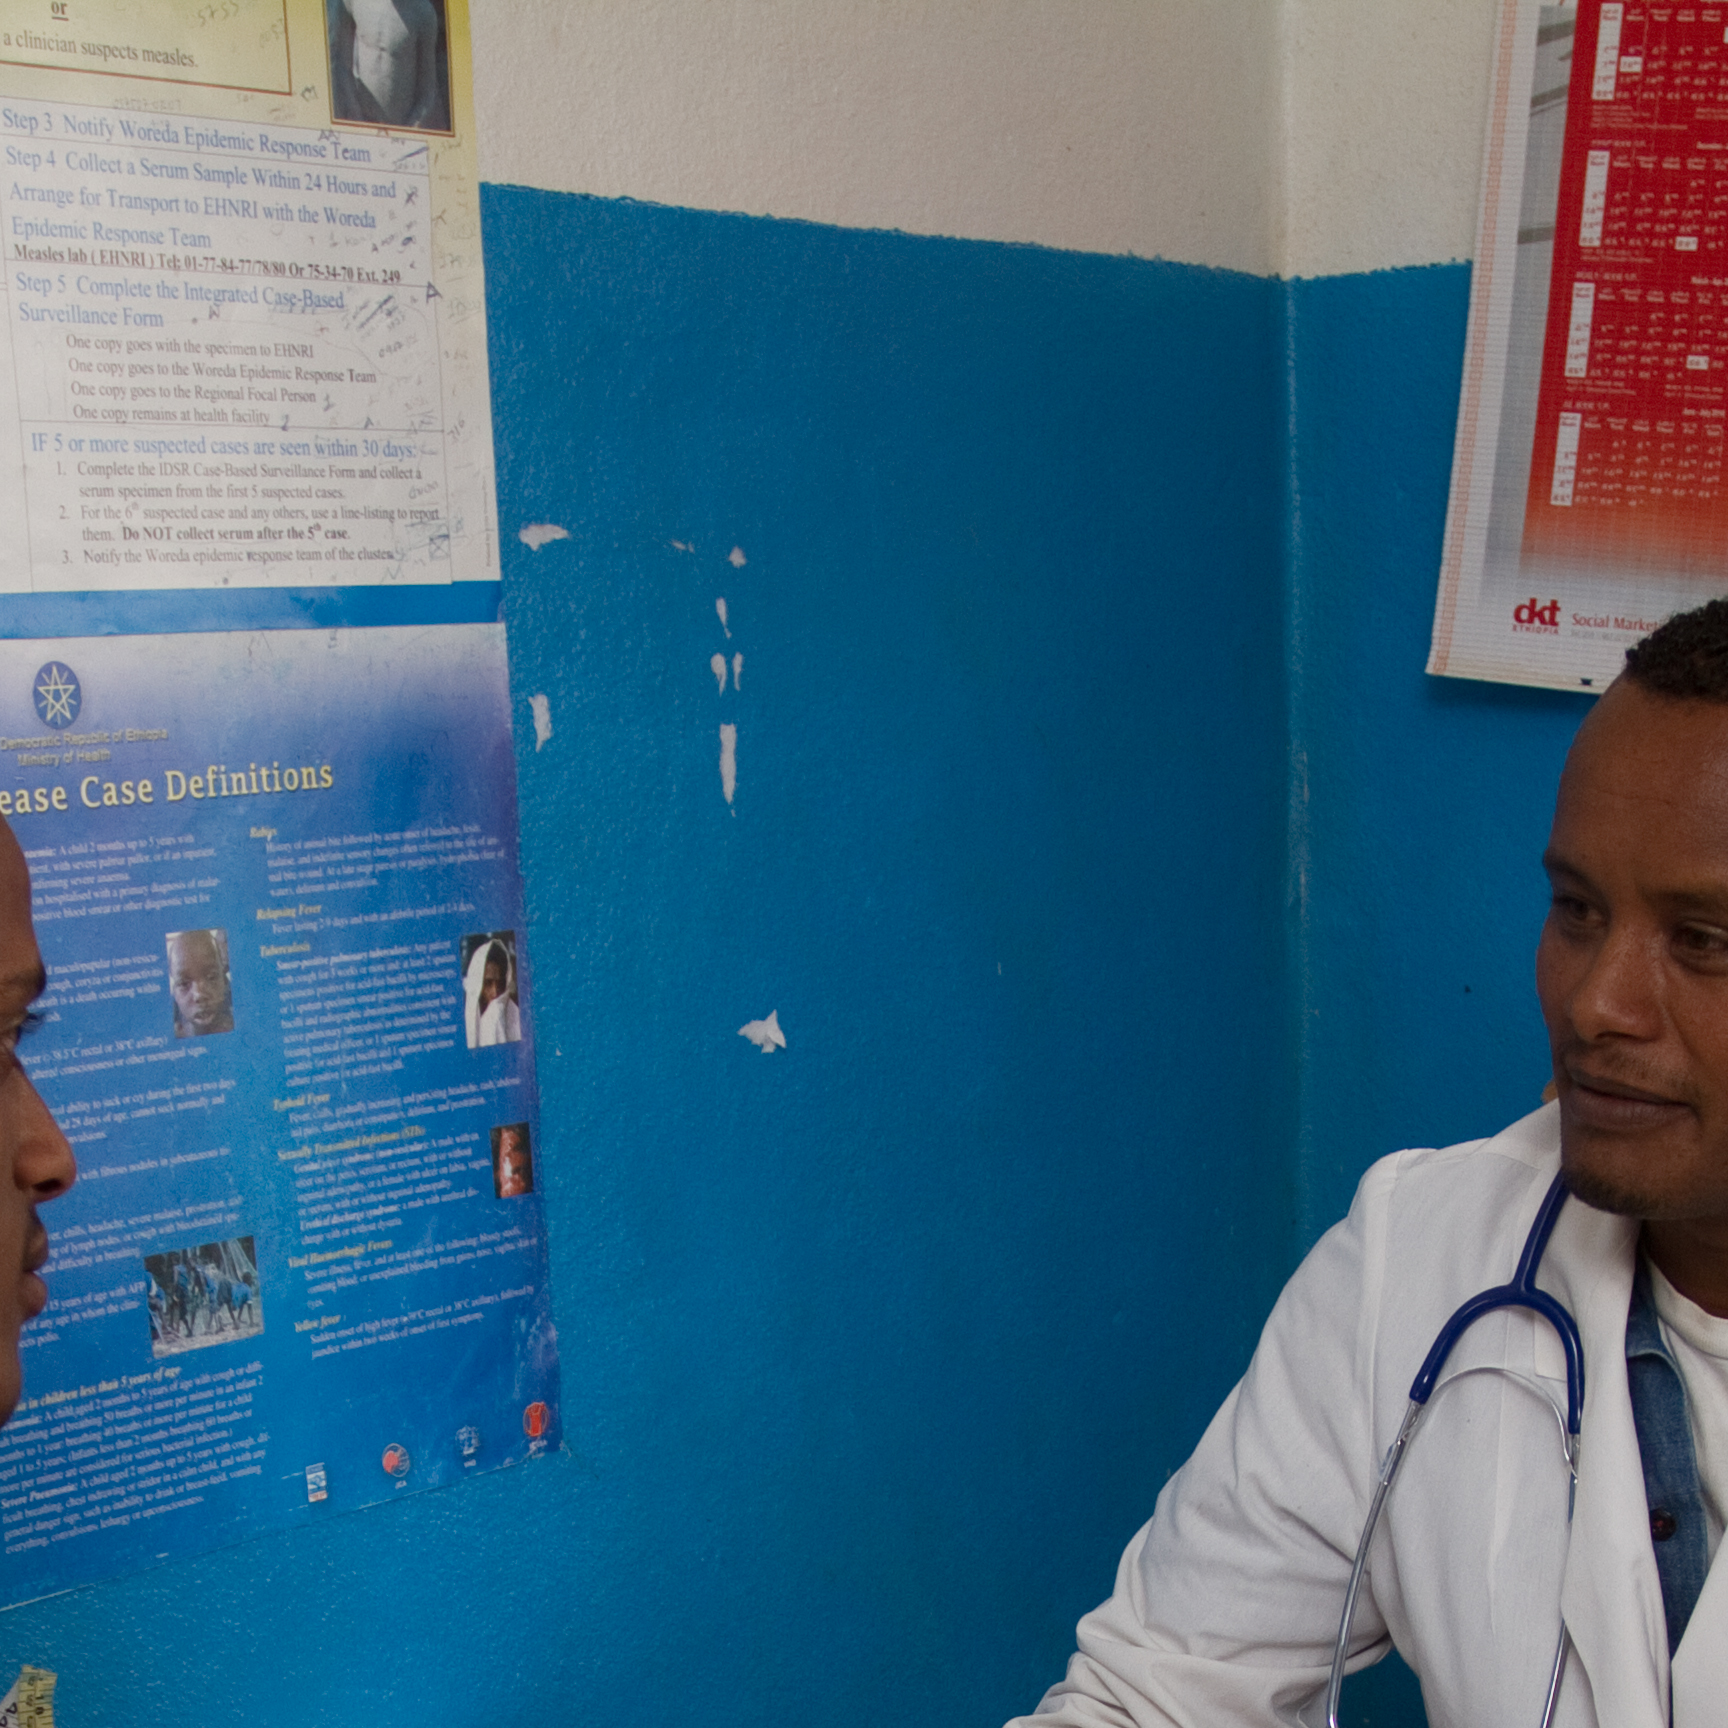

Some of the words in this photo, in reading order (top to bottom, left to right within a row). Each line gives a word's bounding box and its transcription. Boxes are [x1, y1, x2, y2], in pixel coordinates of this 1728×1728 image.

[51, 1, 69, 15] or
[3, 32, 13, 47] a
[14, 29, 78, 54] clinician
[80, 41, 139, 63] suspects
[141, 47, 199, 68] measles.
[2, 108, 39, 135] Step
[43, 111, 53, 132] 3
[62, 113, 115, 143] Notify
[119, 118, 179, 144] Woreda
[184, 126, 254, 156] Epidemic
[259, 134, 327, 164] Response
[330, 138, 372, 163] Team
[1513, 597, 1561, 627] dkt
[1572, 613, 1609, 629] Social
[1613, 616, 1665, 633] Market
[79, 775, 154, 808] Case
[164, 761, 334, 801] Definitions
